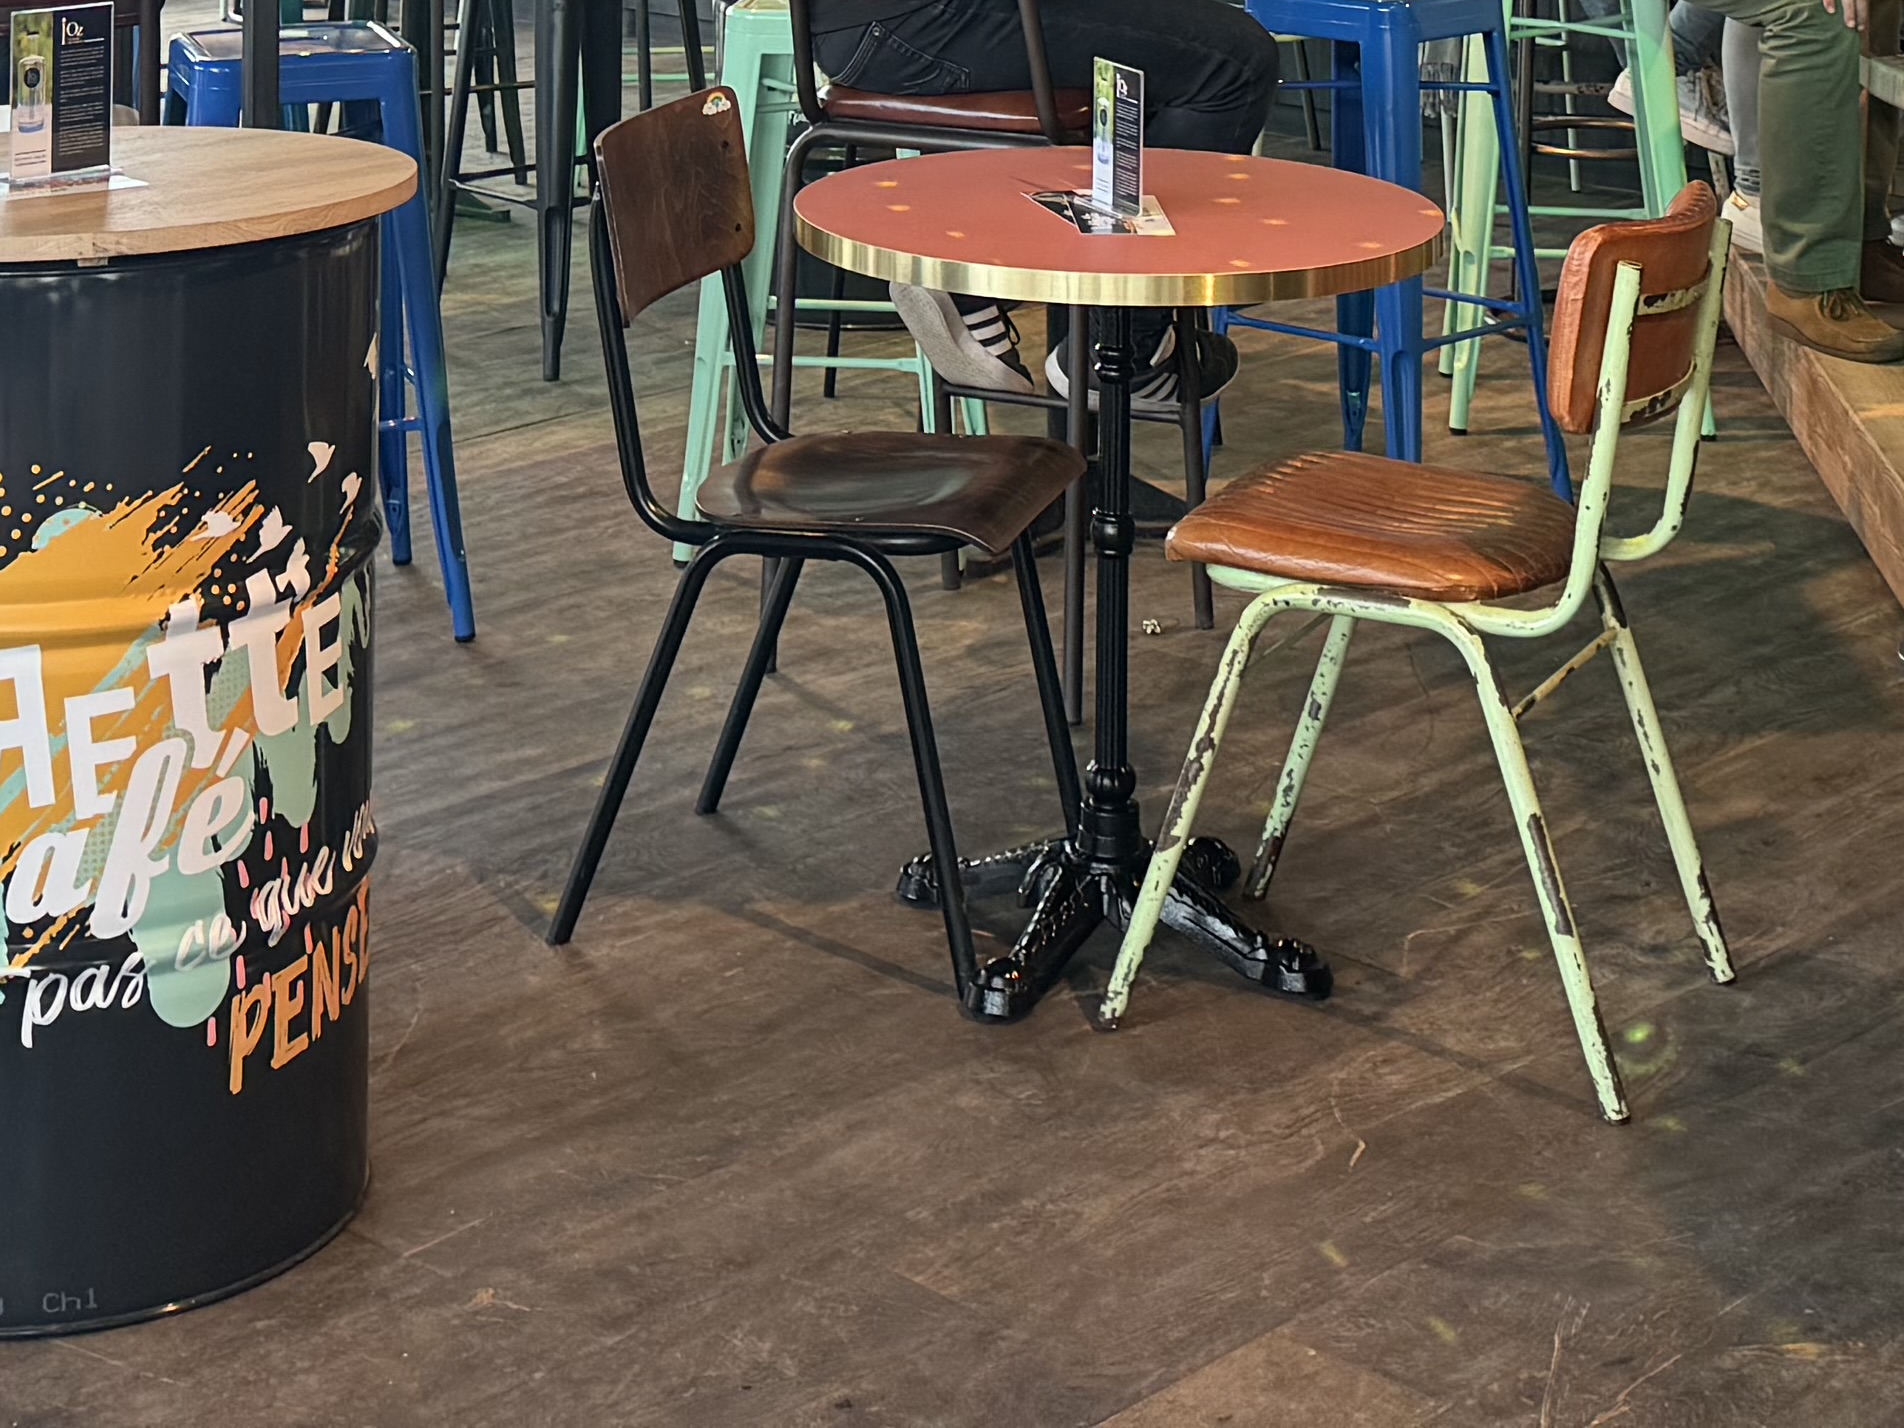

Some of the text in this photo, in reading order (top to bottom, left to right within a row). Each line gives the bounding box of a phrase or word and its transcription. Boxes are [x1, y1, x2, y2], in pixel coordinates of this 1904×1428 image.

[19, 951, 156, 1049] pas
[174, 911, 247, 973] ce
[254, 845, 337, 948] que
